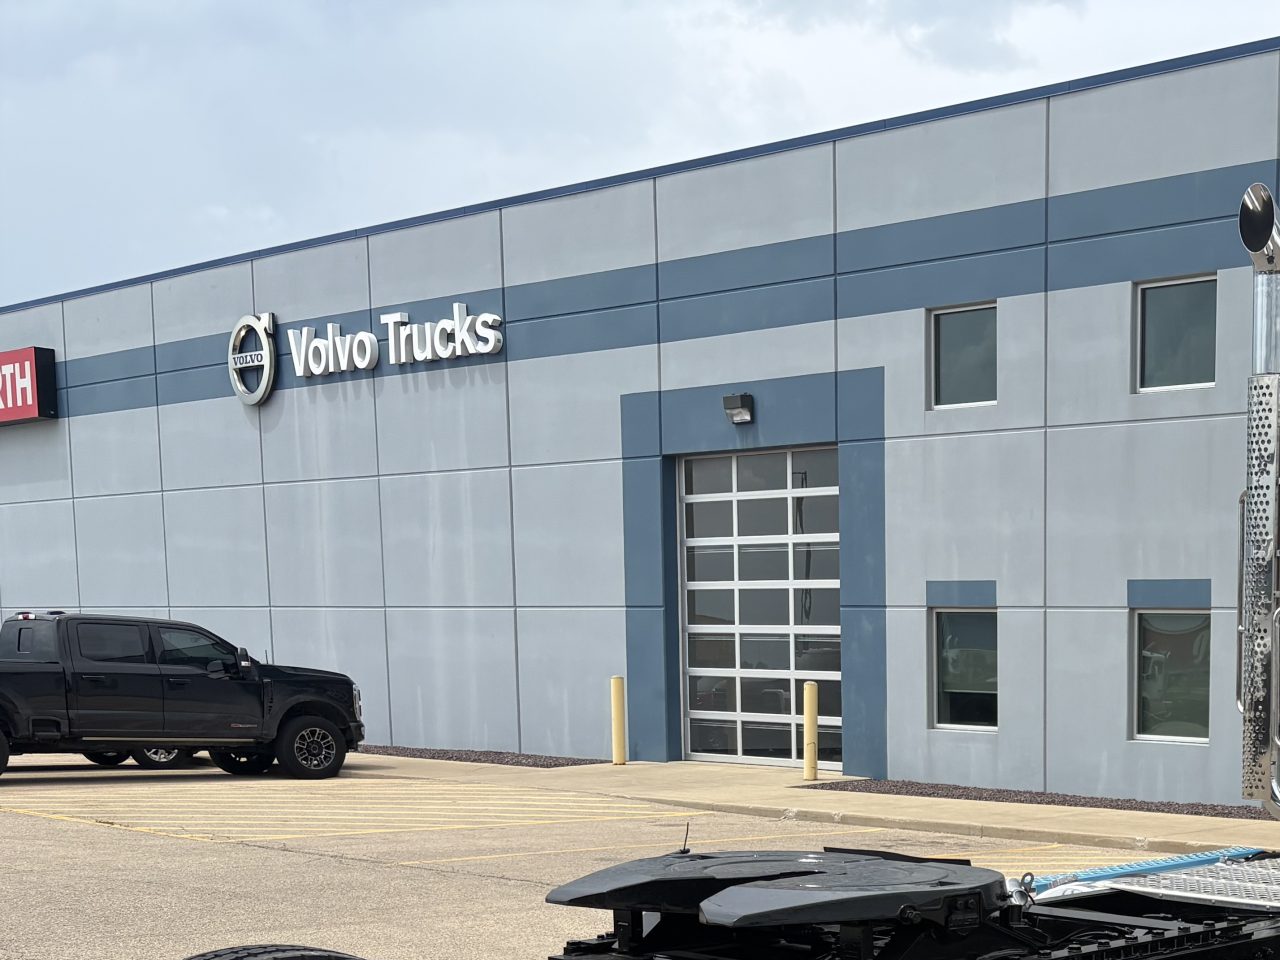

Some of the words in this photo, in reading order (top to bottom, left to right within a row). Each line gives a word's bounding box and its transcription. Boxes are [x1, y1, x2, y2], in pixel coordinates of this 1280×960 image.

[233, 353, 263, 367] VOLVO
[288, 322, 377, 377] Volvo
[380, 303, 503, 364] Trucks
